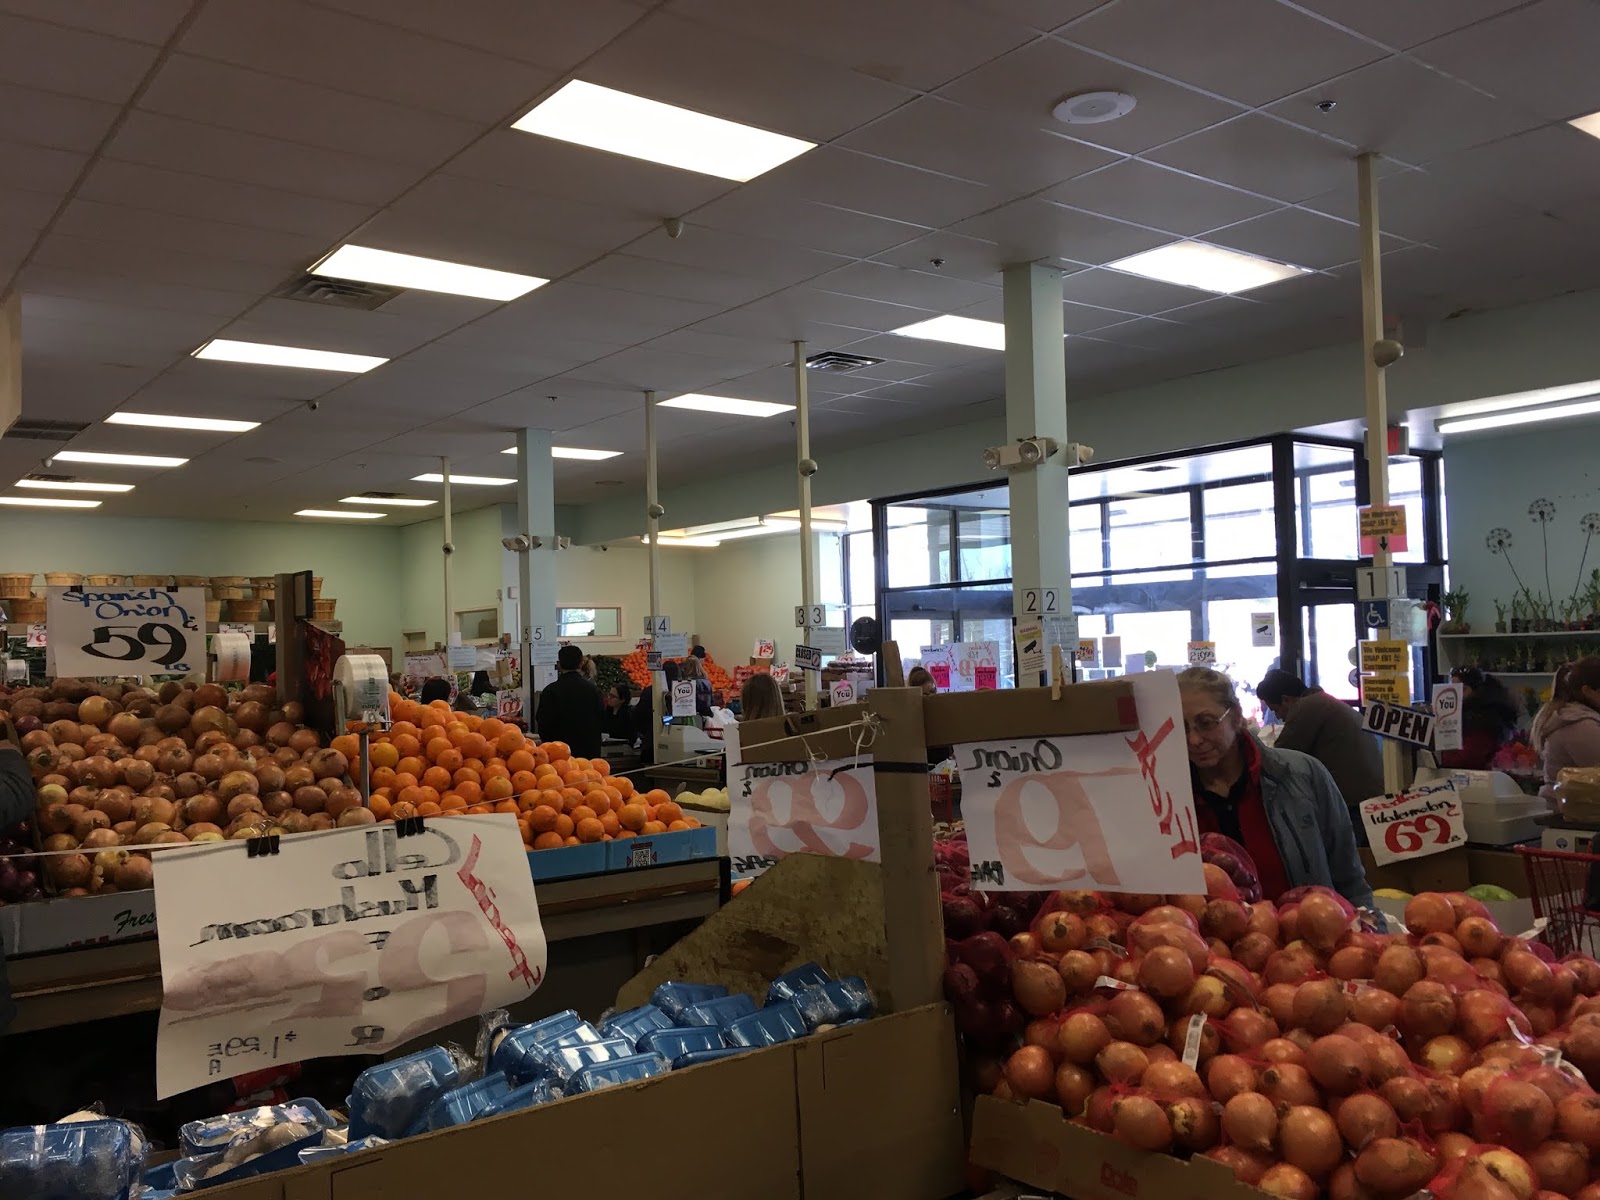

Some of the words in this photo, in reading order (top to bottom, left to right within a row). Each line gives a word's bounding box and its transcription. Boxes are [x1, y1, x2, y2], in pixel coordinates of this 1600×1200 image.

[1366, 572, 1374, 597] 1
[1394, 570, 1400, 596] 1
[62, 588, 175, 607] Spanish
[1026, 591, 1036, 612] 2
[1046, 590, 1056, 611] 2
[95, 602, 189, 622] Onion
[798, 608, 805, 625] 3
[813, 607, 822, 624] 3
[524, 628, 529, 641] 5
[534, 628, 542, 640] 5
[646, 618, 652, 632] 4
[658, 618, 666, 632] 4
[81, 622, 187, 665] 59
[796, 647, 812, 660] CLOSED
[1440, 700, 1454, 710] You
[1368, 704, 1430, 744] OPEN
[1364, 793, 1422, 814] Seedless
[1418, 780, 1455, 796] Sweet
[1371, 800, 1453, 825] Watermelon
[1385, 814, 1451, 853] 69
[114, 910, 156, 934] Fres
